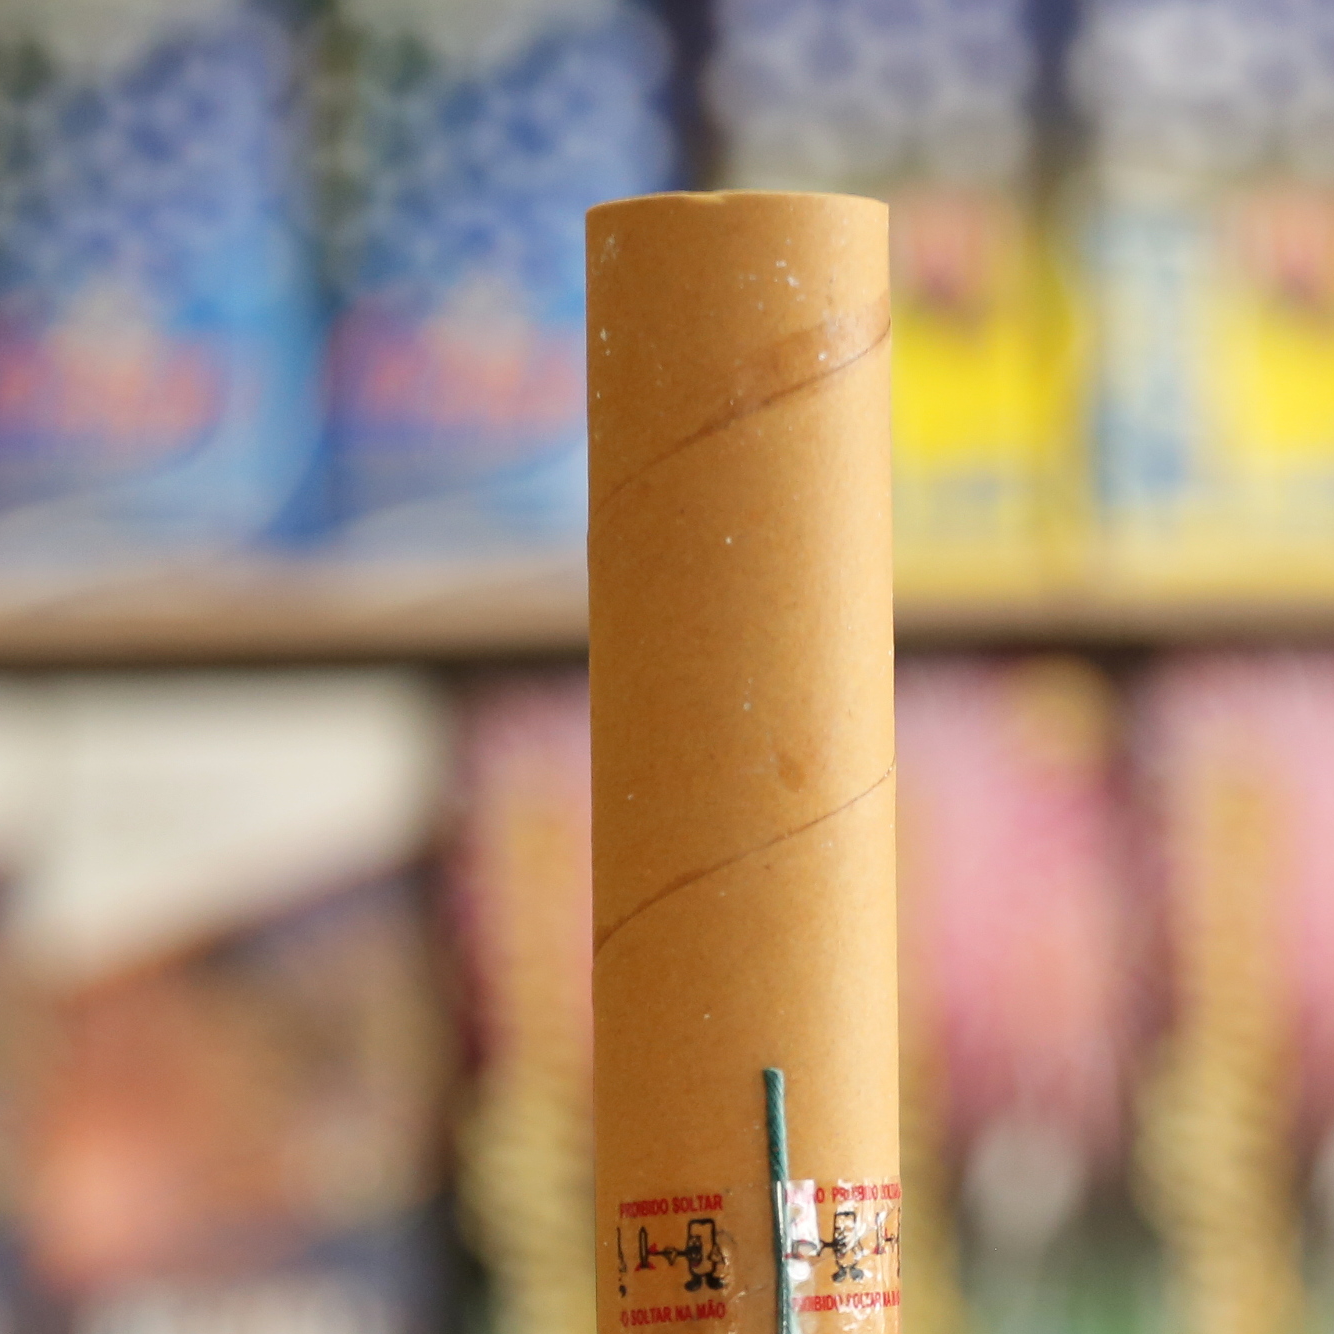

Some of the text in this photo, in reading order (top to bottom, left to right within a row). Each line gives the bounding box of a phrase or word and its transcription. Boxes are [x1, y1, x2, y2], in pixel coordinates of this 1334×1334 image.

[672, 1194, 723, 1214] SOLTAR
[846, 1292, 881, 1309] SOLTAR
[630, 1306, 672, 1326] SOLTAR
[675, 1304, 692, 1321] NA
[696, 1299, 726, 1320] MÃO
